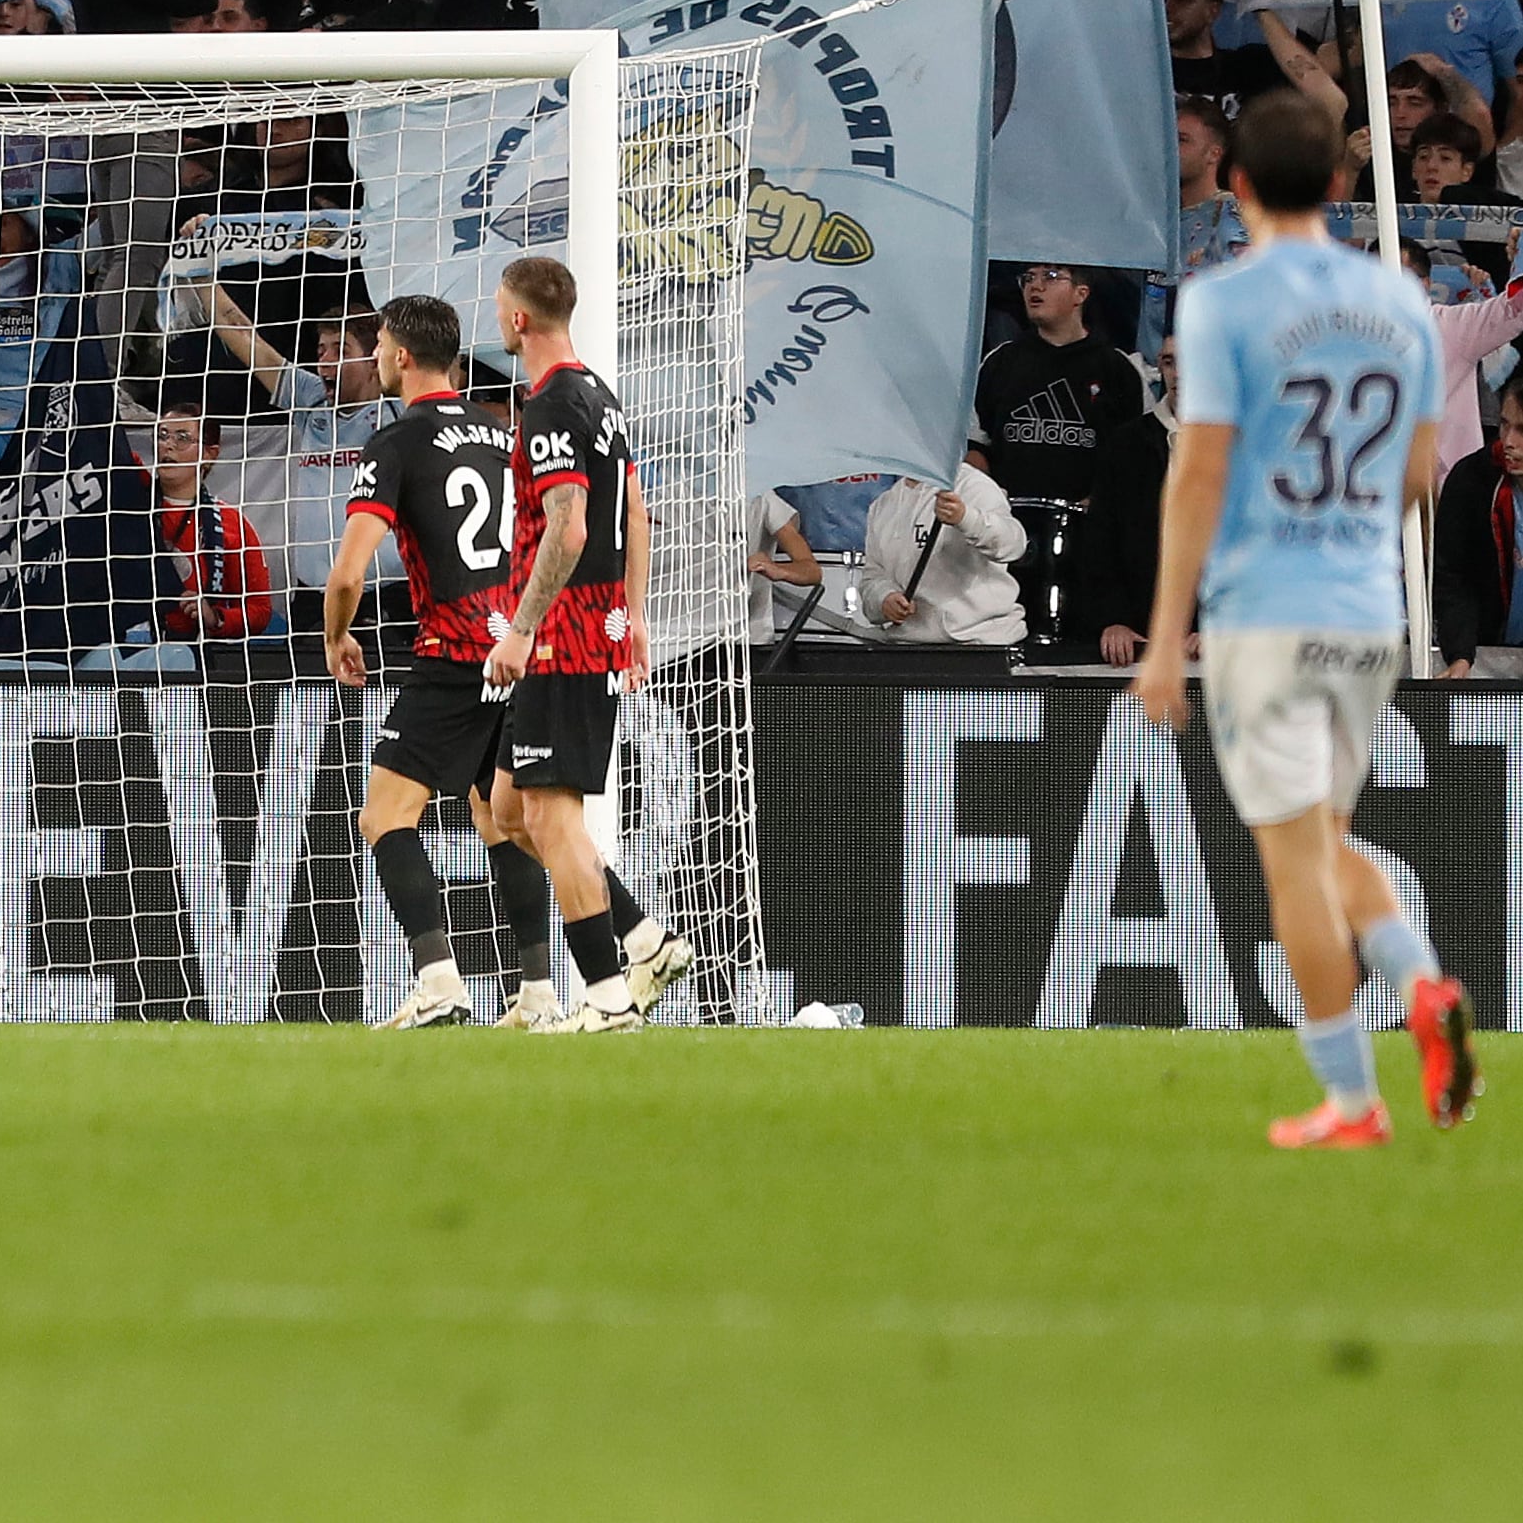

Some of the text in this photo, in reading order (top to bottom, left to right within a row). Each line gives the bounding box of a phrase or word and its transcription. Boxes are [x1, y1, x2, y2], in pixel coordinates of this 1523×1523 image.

[529, 431, 575, 460] OK
[1002, 418, 1098, 450] adidas
[1272, 372, 1403, 511] 32
